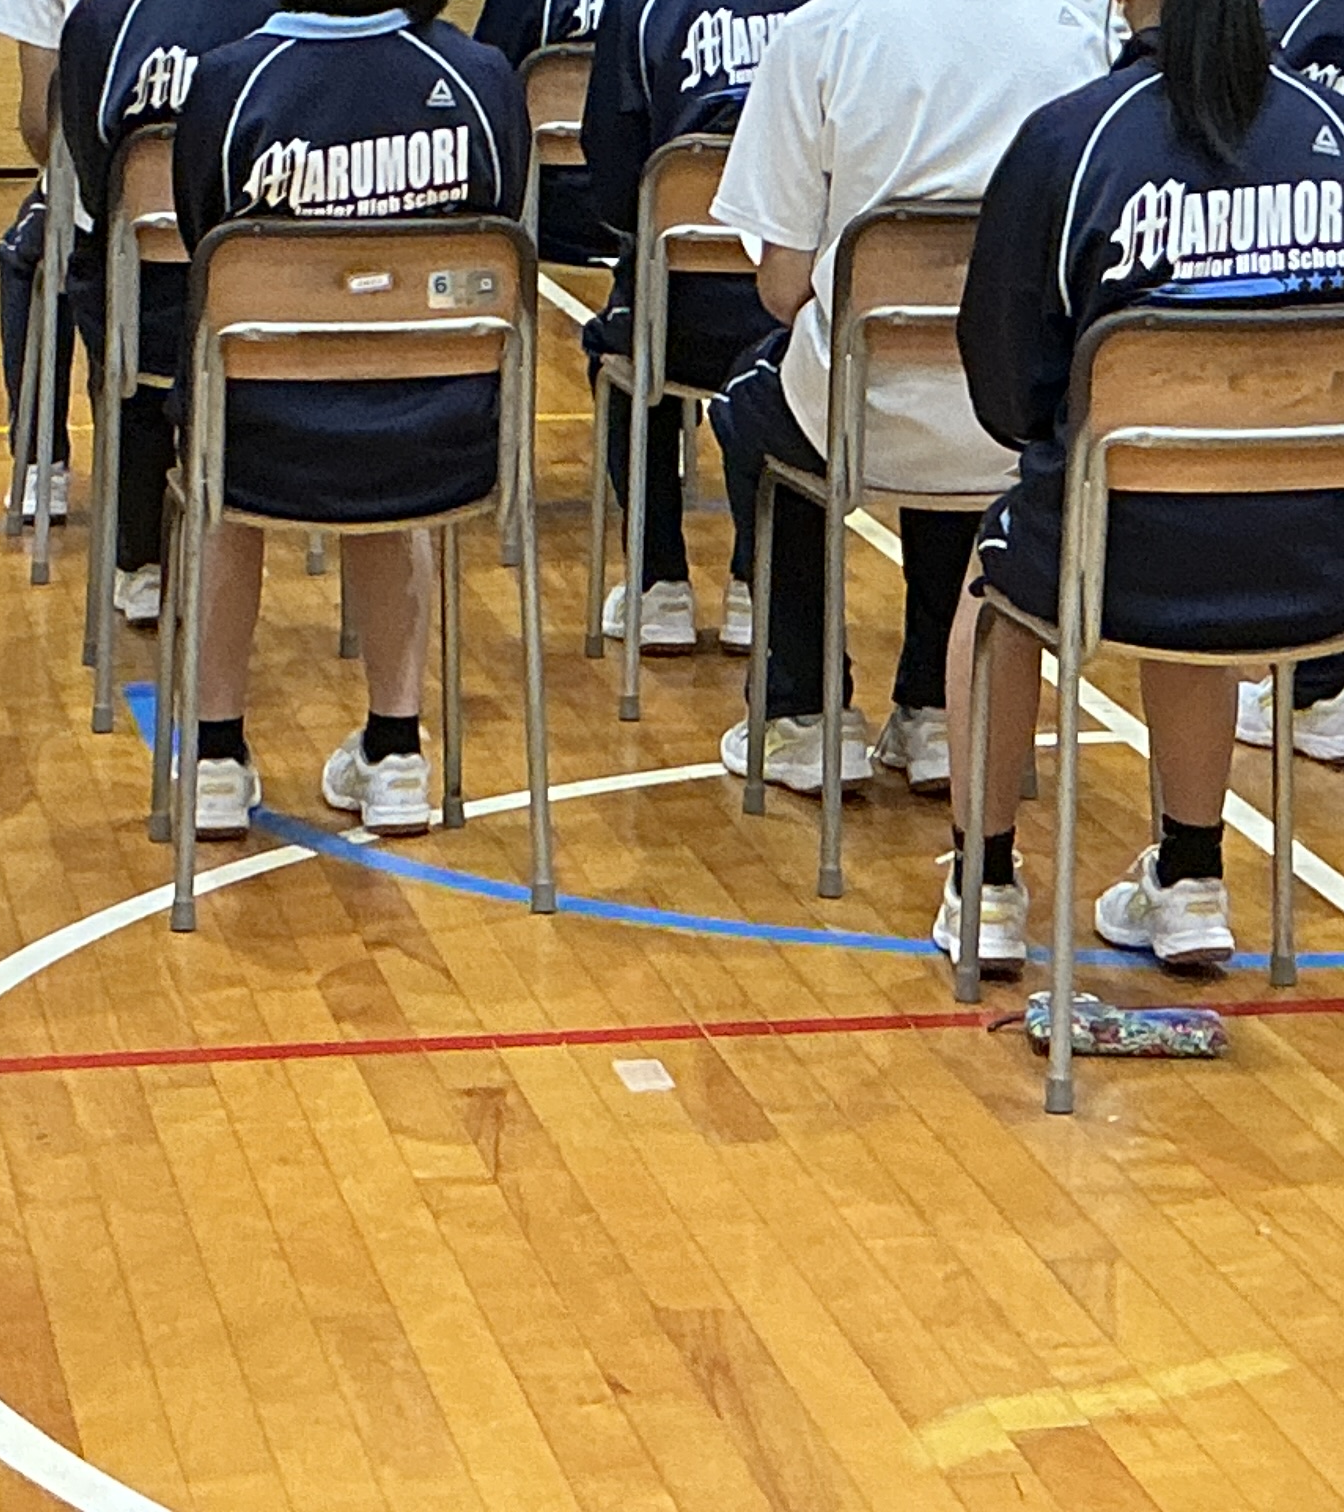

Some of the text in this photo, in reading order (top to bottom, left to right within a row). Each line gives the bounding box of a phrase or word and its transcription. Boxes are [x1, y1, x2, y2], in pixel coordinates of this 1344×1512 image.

[234, 125, 469, 217] MARUMORI
[356, 196, 401, 217] High
[404, 183, 469, 212] School
[1171, 257, 1234, 281] Junior
[1235, 251, 1286, 275] High
